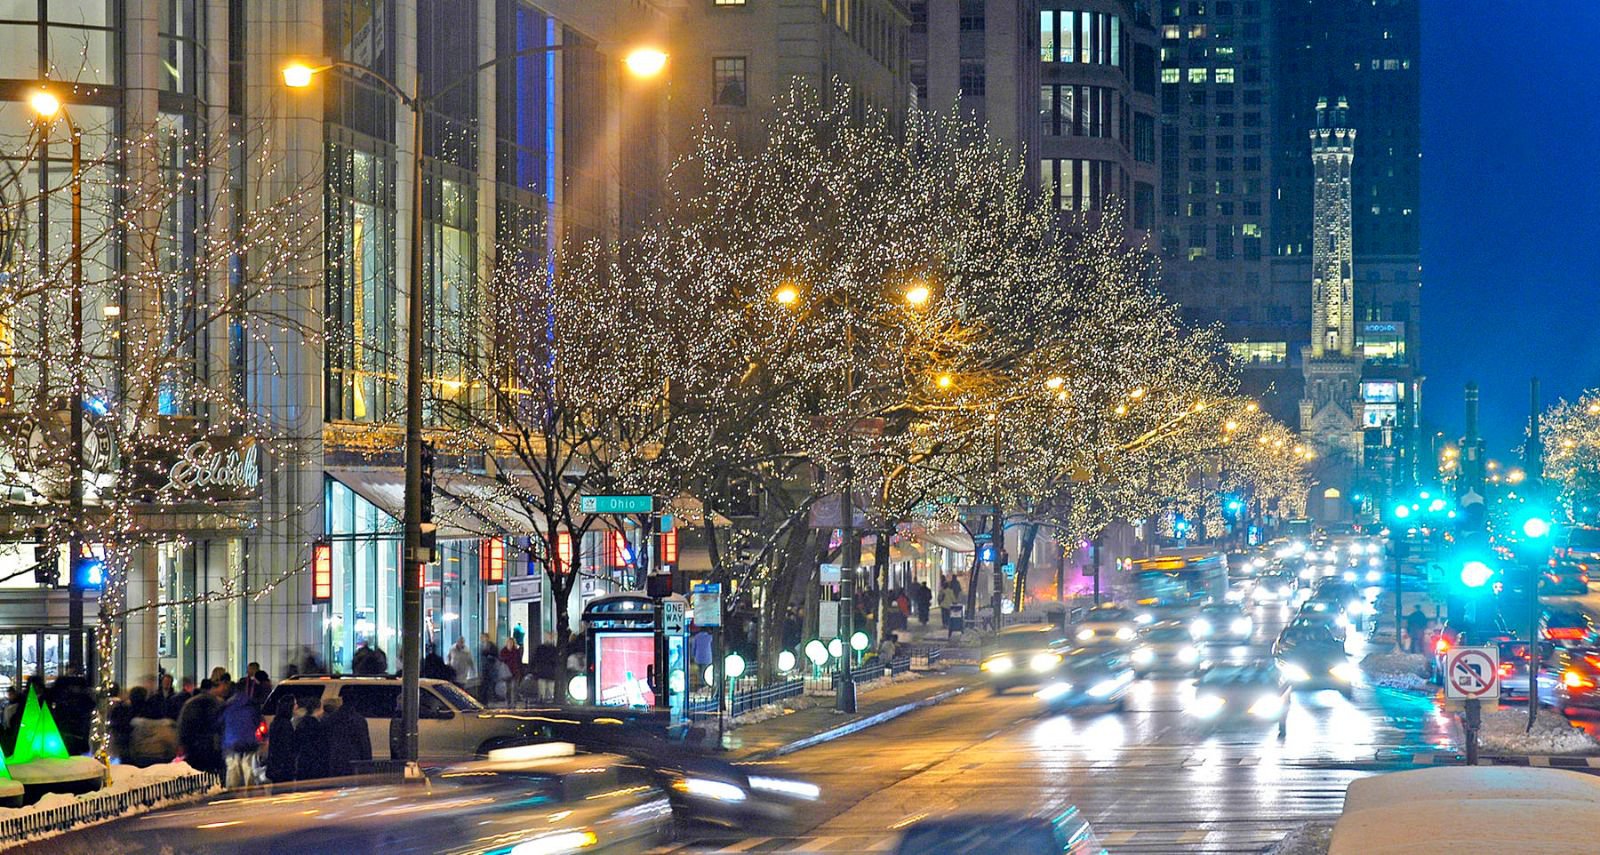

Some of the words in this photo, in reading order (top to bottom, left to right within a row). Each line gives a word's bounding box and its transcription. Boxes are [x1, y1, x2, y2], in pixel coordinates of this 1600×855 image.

[610, 498, 635, 509] Ohio
[666, 603, 683, 613] ONE
[666, 614, 683, 622] WAY
